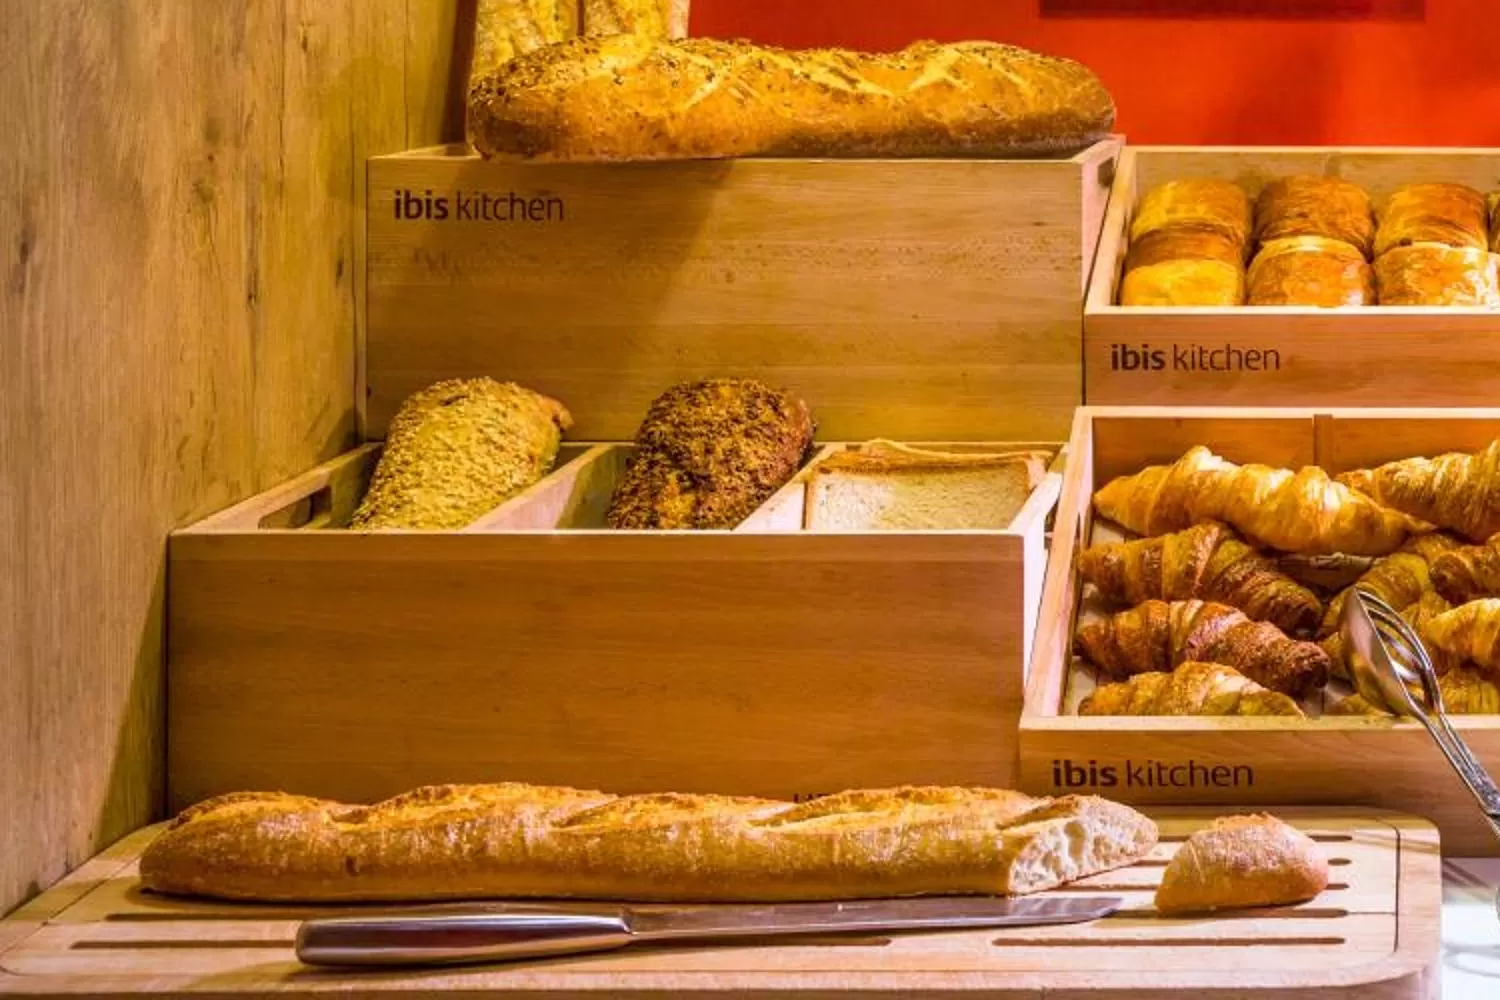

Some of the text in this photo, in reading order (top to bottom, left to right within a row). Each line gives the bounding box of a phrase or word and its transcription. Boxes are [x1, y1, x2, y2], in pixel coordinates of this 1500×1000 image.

[393, 189, 565, 221] ibis kitchen
[1110, 343, 1281, 371] ibis kitchen
[1052, 760, 1254, 787] ibis kitchen
